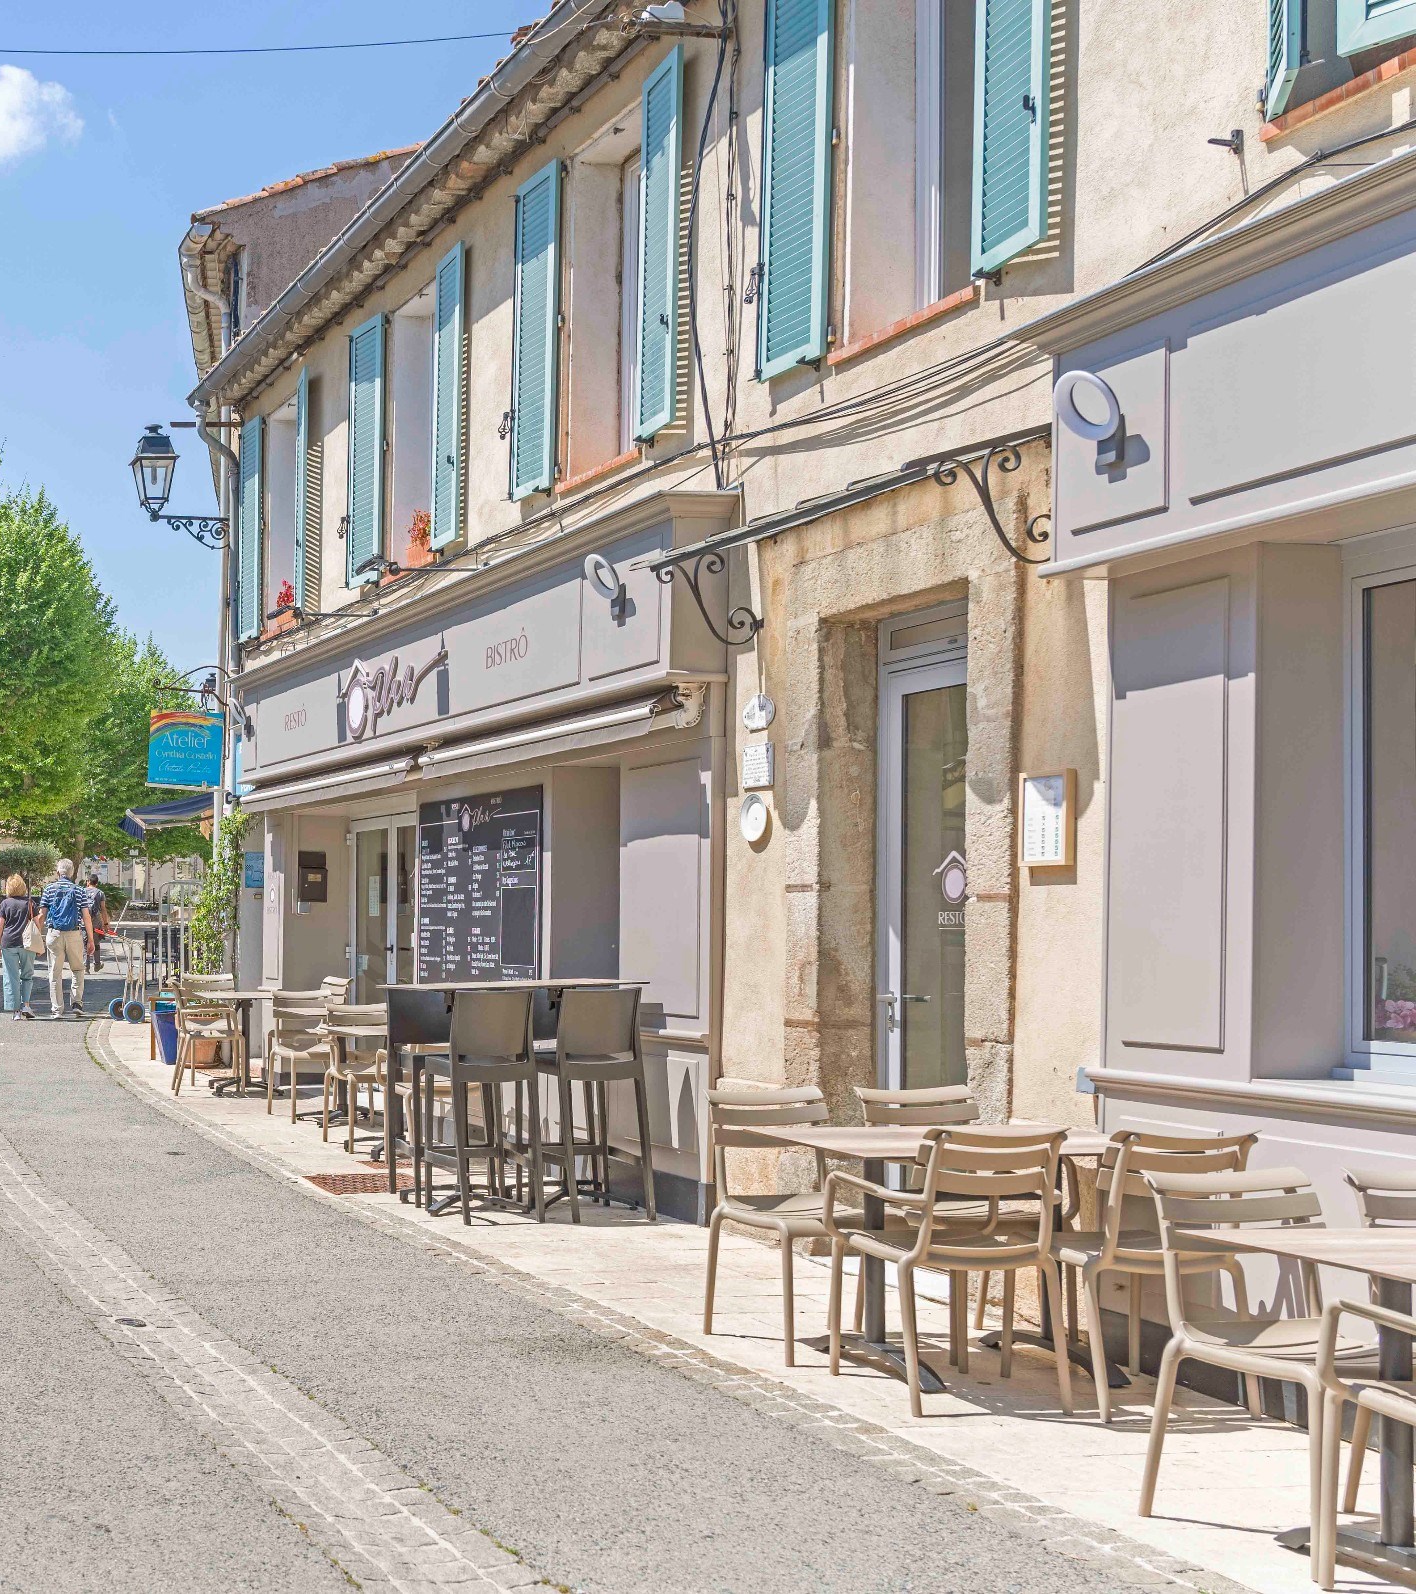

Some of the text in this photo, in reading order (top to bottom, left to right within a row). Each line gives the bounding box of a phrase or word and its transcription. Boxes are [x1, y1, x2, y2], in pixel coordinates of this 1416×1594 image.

[486, 627, 528, 669] BISTRÔ
[285, 703, 307, 731] RESTÔ
[162, 731, 211, 749] Atelier
[155, 749, 184, 760] Cynthia
